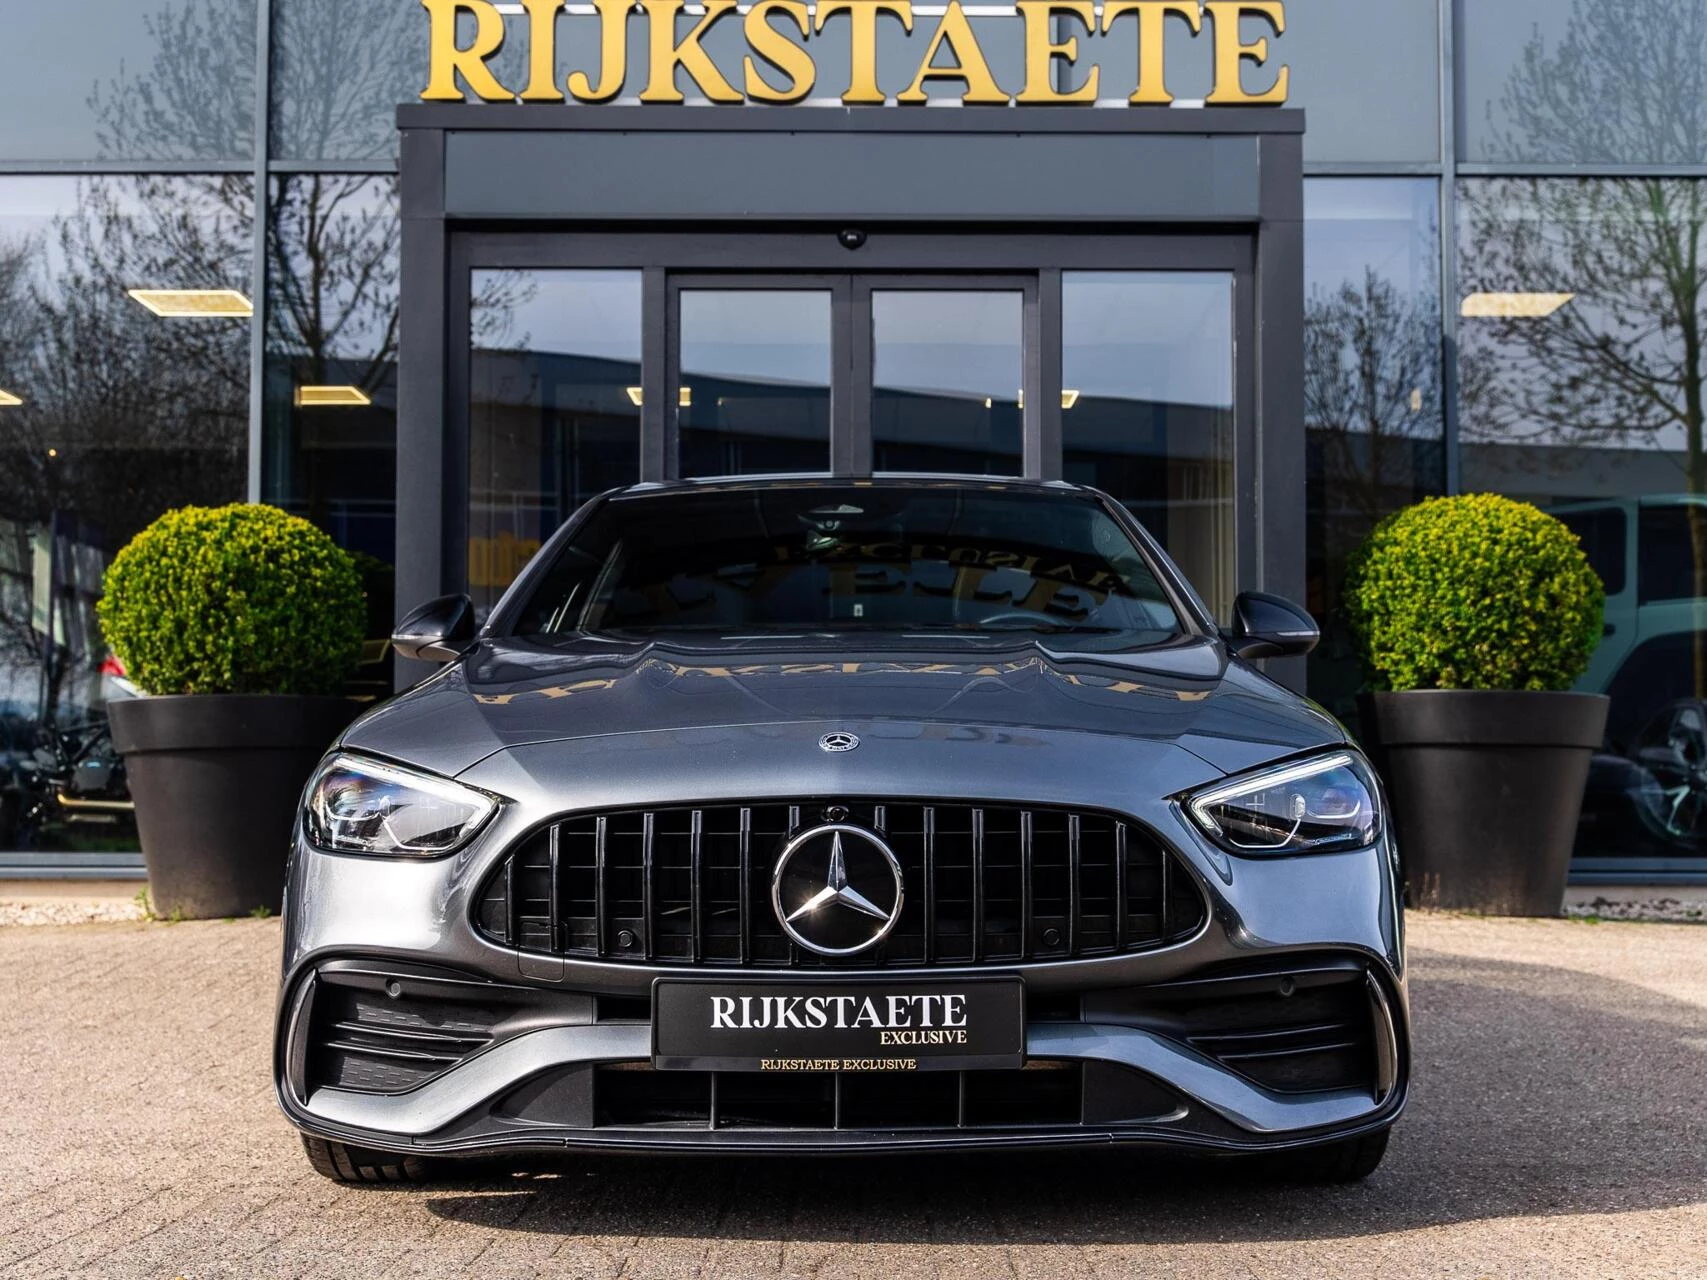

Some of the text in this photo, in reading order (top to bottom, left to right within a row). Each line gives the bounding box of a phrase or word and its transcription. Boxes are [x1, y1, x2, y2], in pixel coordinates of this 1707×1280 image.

[420, 0, 1289, 104] RIJKSTAETE
[710, 994, 967, 1029] RIJKSTAETE
[880, 1029, 967, 1046] EXCLUSIVE
[760, 1058, 917, 1071] RIJKSTAETE EXCLUSIVE
